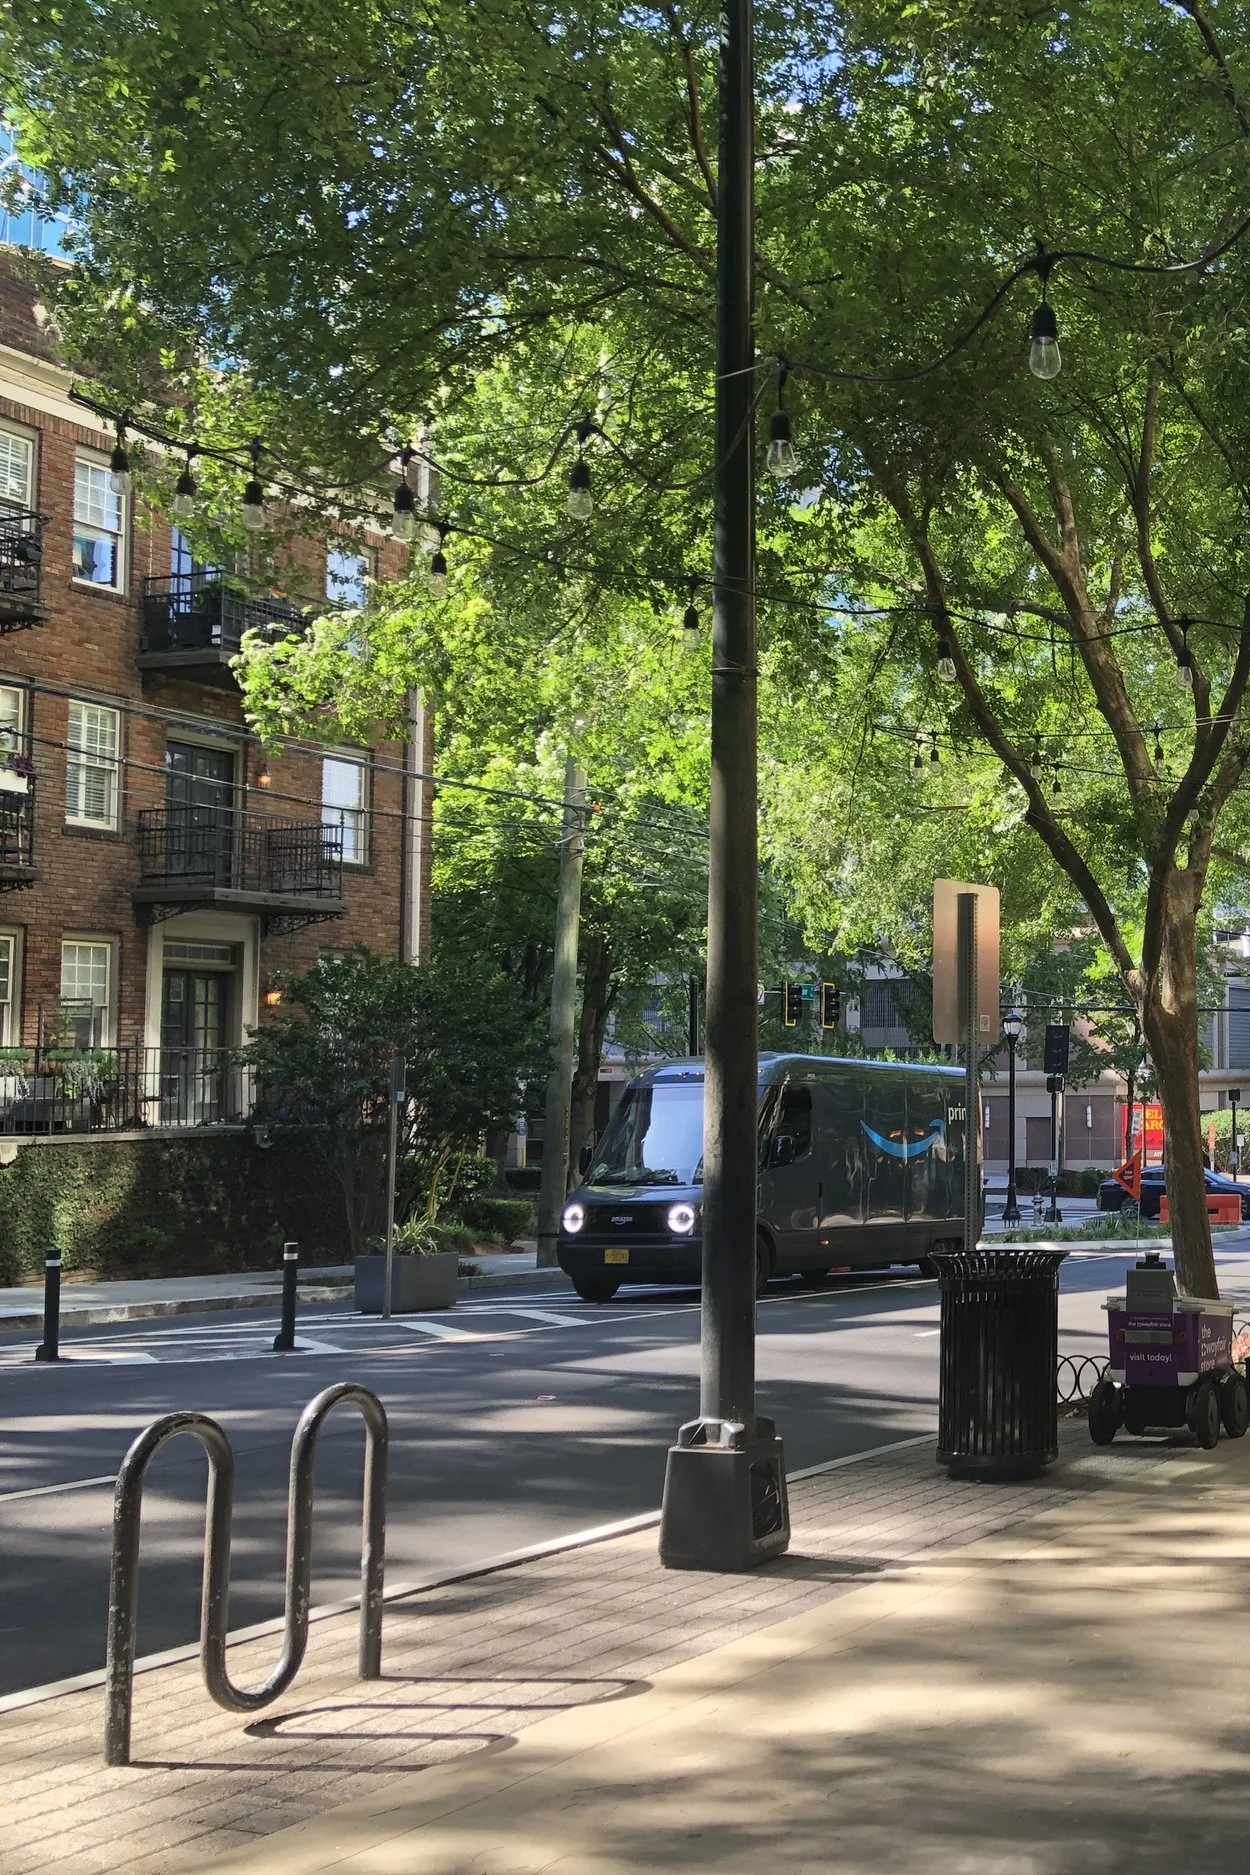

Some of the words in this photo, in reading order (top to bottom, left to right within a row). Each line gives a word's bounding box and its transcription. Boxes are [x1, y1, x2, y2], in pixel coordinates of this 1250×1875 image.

[1201, 1323, 1211, 1338] the
[1129, 1353, 1145, 1361] visit
[1147, 1353, 1172, 1363] today!
[1200, 1359, 1215, 1372] store
